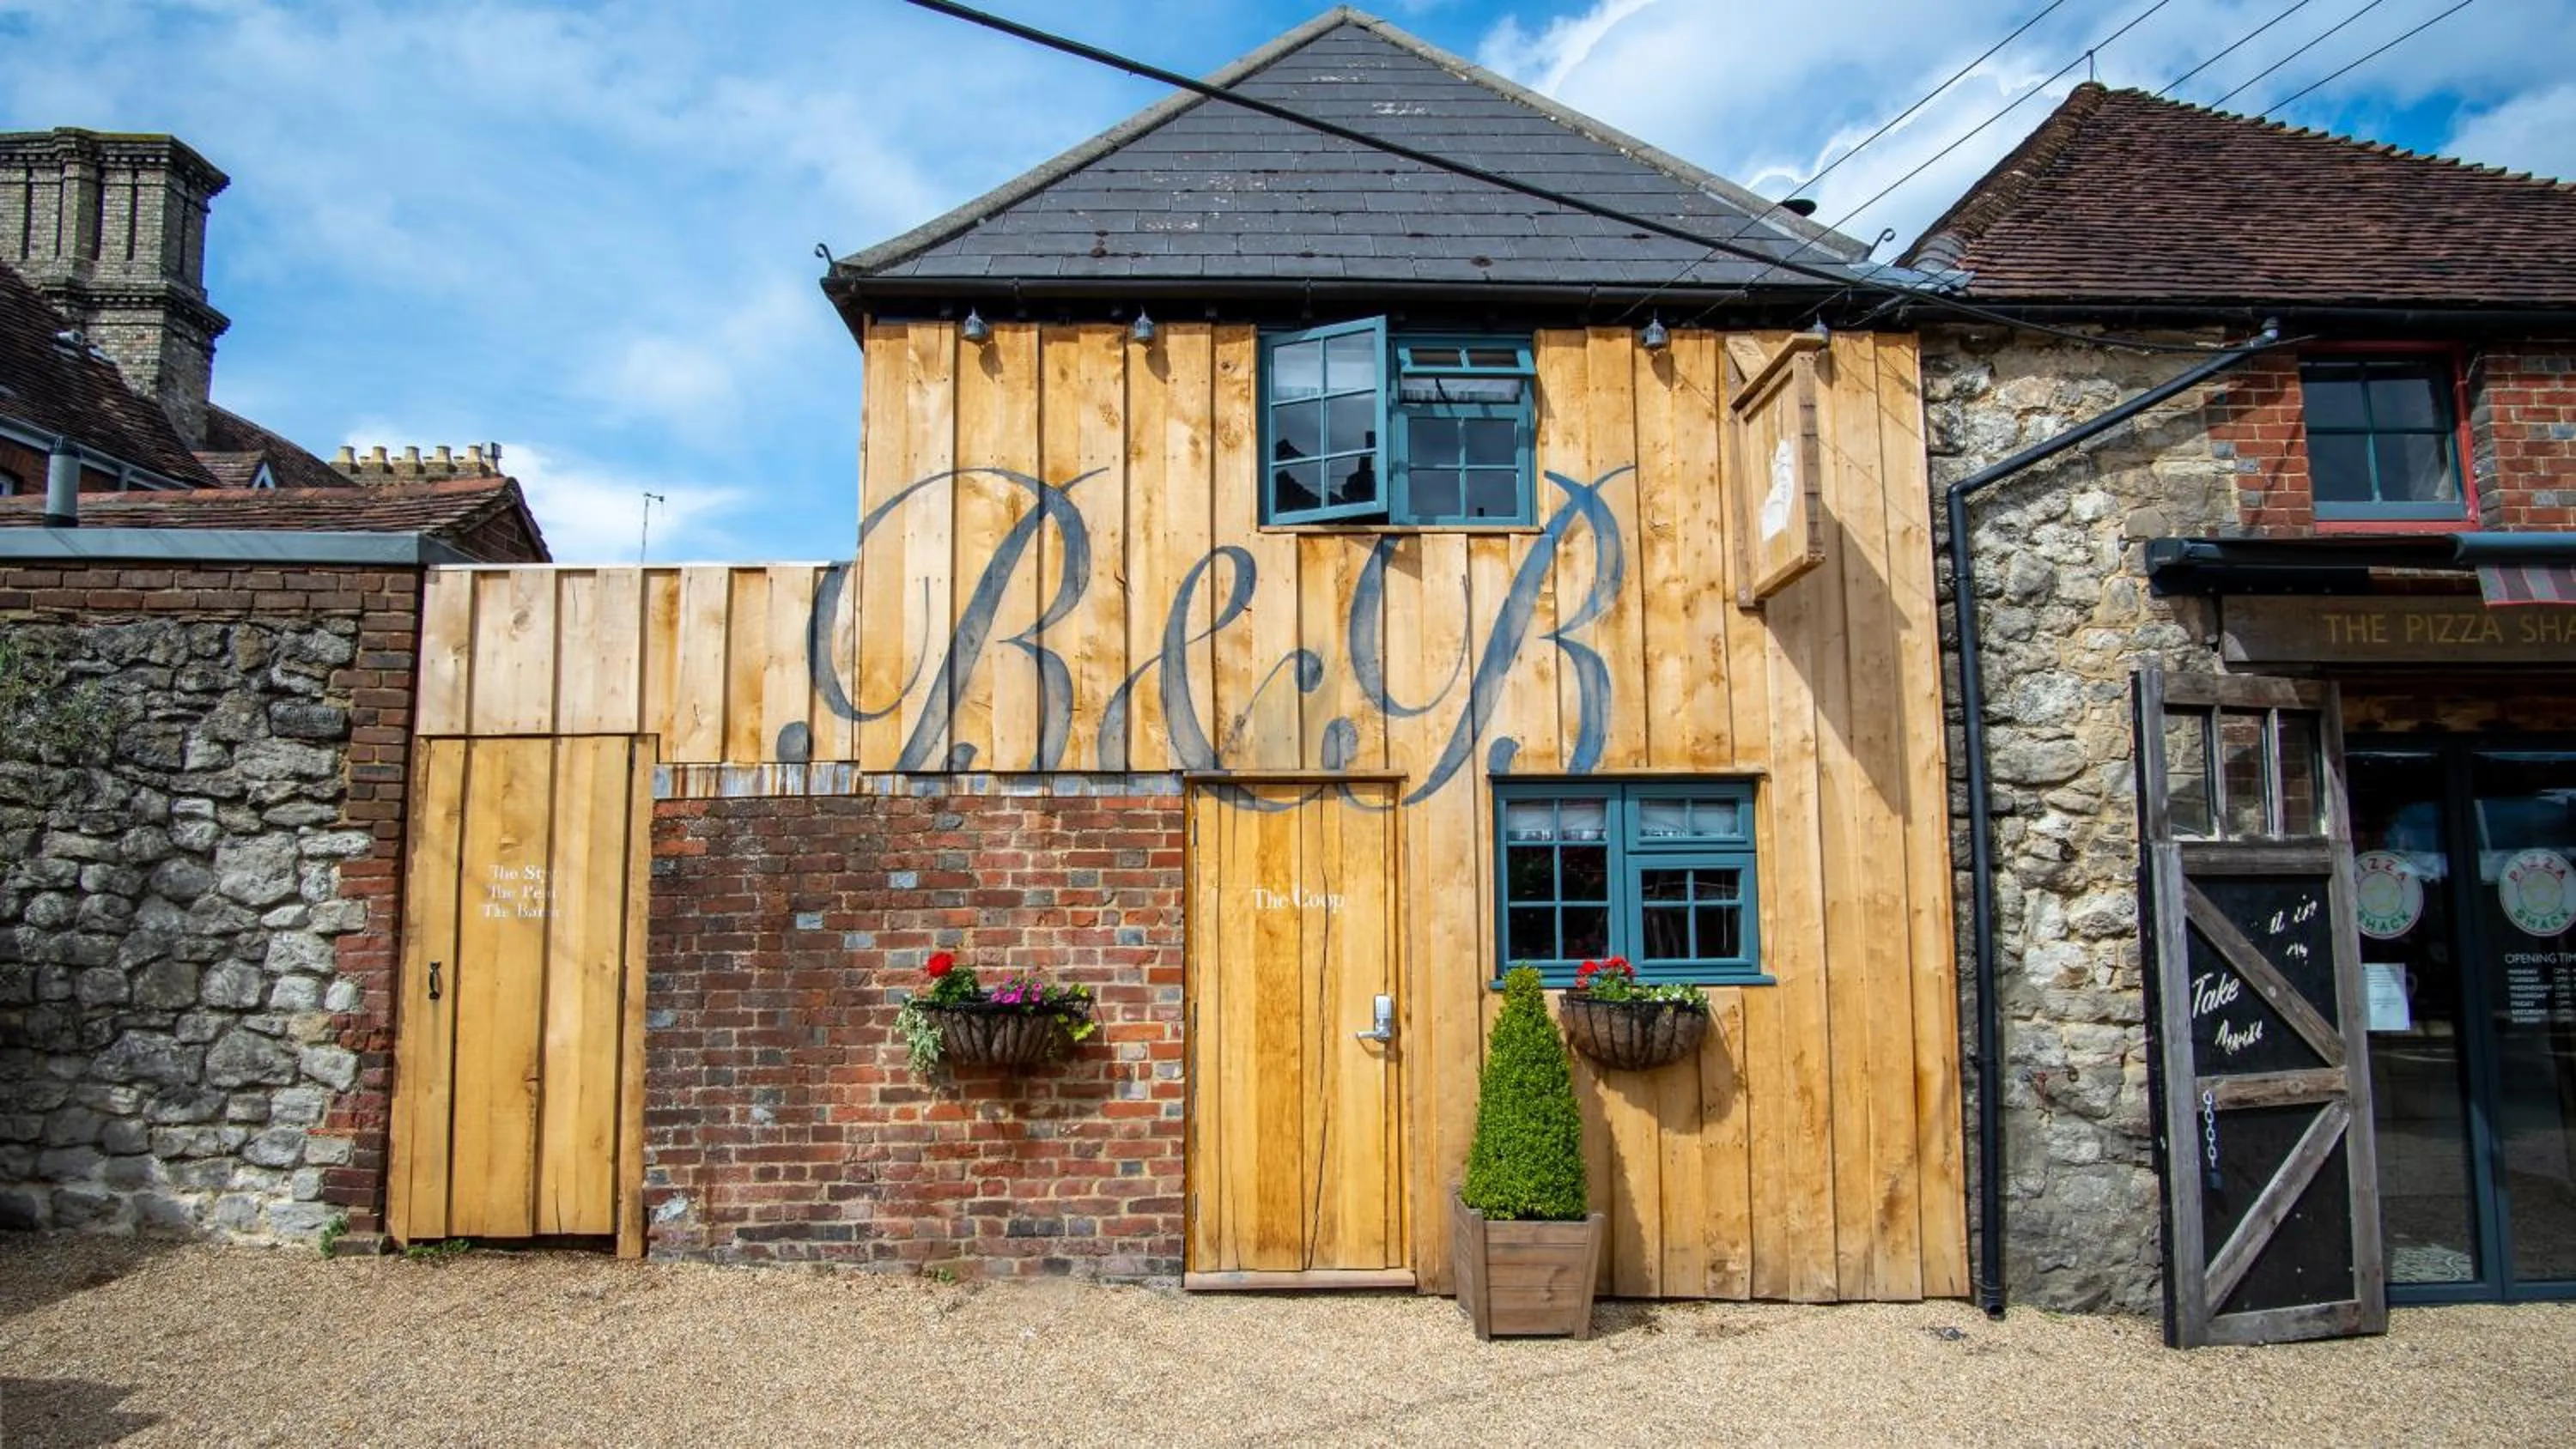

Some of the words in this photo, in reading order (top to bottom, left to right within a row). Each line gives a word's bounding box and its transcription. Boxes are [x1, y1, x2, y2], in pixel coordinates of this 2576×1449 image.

[2323, 613, 2389, 644] THE
[2405, 613, 2504, 644] PIZZA
[489, 864, 519, 880] The
[1250, 887, 1289, 908] The
[1293, 887, 1345, 914] Coop
[2505, 953, 2556, 963] OPENING
[2192, 972, 2239, 1019] Take
